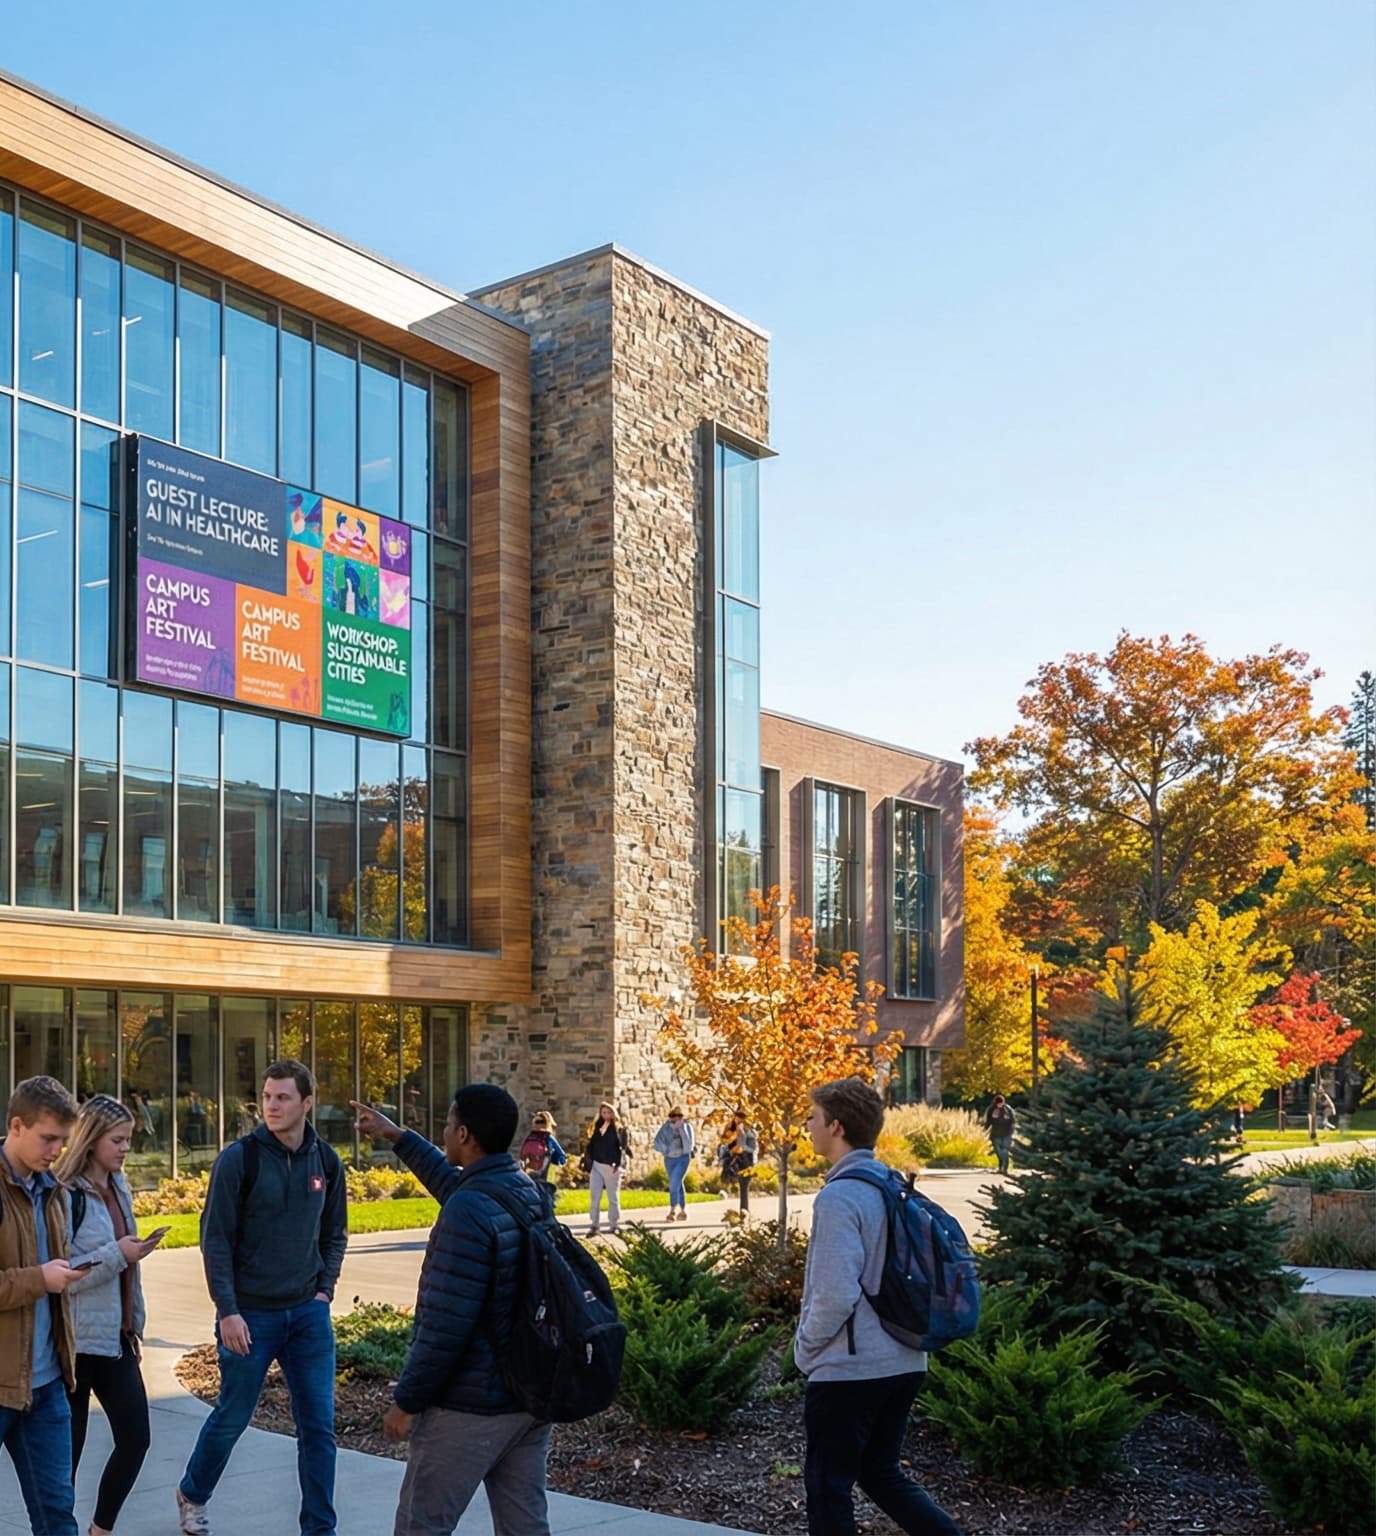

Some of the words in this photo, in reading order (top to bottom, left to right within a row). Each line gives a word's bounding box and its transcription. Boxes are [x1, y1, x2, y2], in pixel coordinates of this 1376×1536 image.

[146, 479, 197, 510] GUEST
[146, 502, 161, 522] AI
[166, 505, 181, 528] IN
[186, 513, 279, 557] HEALTHCARE
[146, 574, 210, 607] CAMPUS
[145, 596, 177, 619] ART
[242, 600, 301, 631] CAMPUS
[146, 616, 216, 650] FESTIVAL
[242, 621, 271, 643] ART
[242, 640, 305, 672] FESTIVAL
[327, 642, 407, 676] SUSTAINABLE
[327, 661, 366, 685] CITIES
